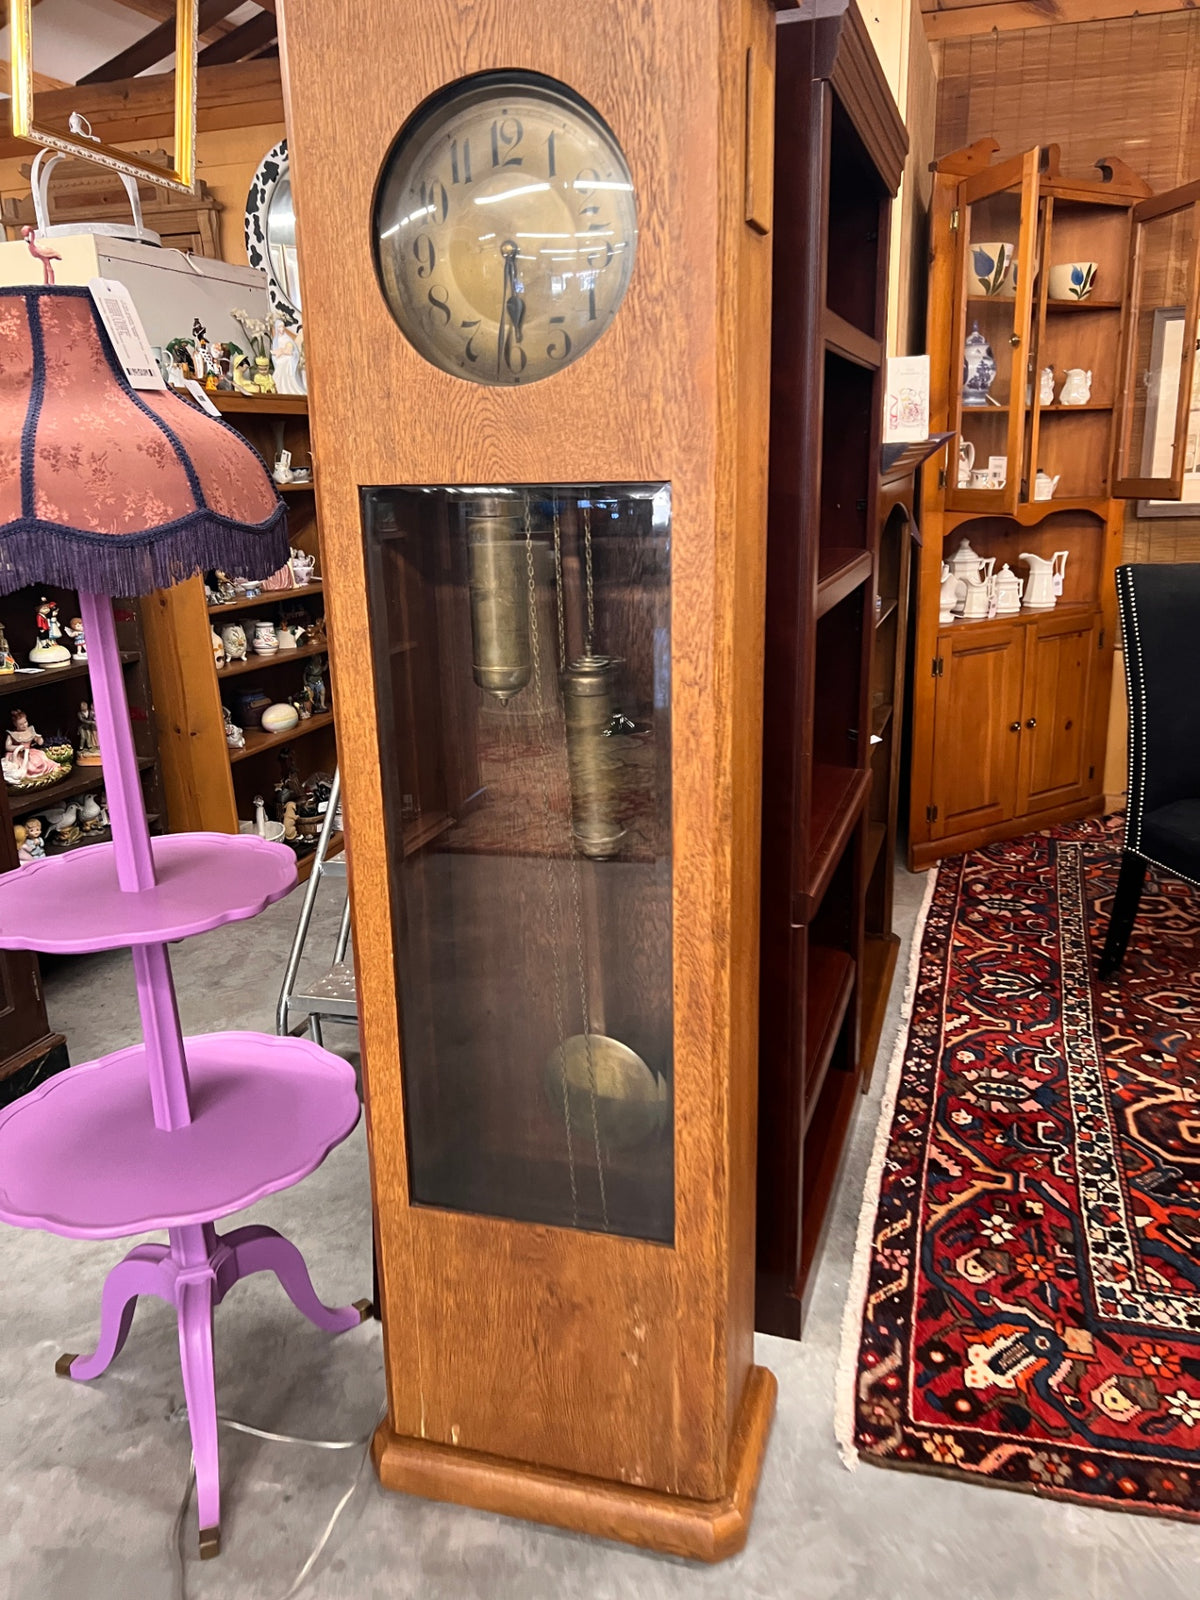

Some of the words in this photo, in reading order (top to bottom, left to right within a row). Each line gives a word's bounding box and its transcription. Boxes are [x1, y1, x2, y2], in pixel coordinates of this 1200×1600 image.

[451, 138, 473, 185] 11
[490, 118, 523, 168] 12
[545, 130, 557, 178] 1
[420, 179, 449, 225] 10
[575, 168, 601, 215] 2
[413, 234, 436, 279] 9
[427, 284, 451, 327] 8
[461, 319, 482, 362] 7
[503, 332, 527, 374] 6
[546, 316, 572, 360] 5
